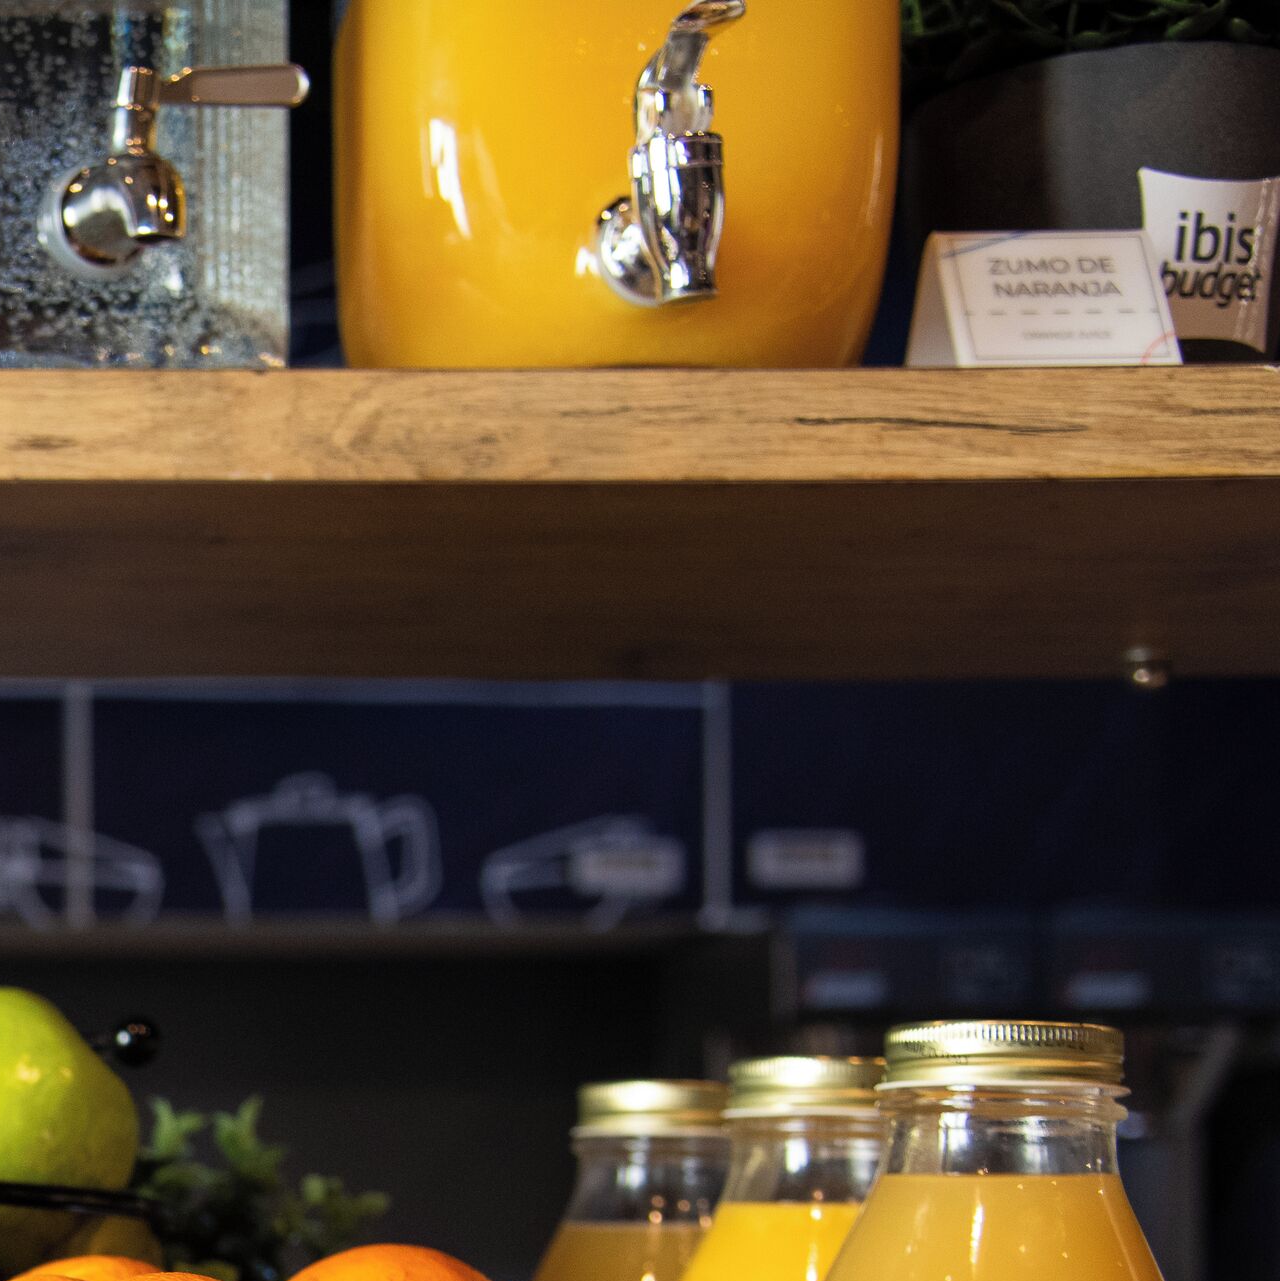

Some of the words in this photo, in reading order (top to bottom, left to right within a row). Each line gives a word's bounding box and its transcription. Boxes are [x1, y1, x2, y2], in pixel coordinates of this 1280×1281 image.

[1175, 211, 1255, 264] ibis
[987, 256, 1071, 275] ZUMO
[1078, 256, 1116, 275] DE
[993, 278, 1123, 298] NARANJA
[1160, 260, 1261, 308] budget
